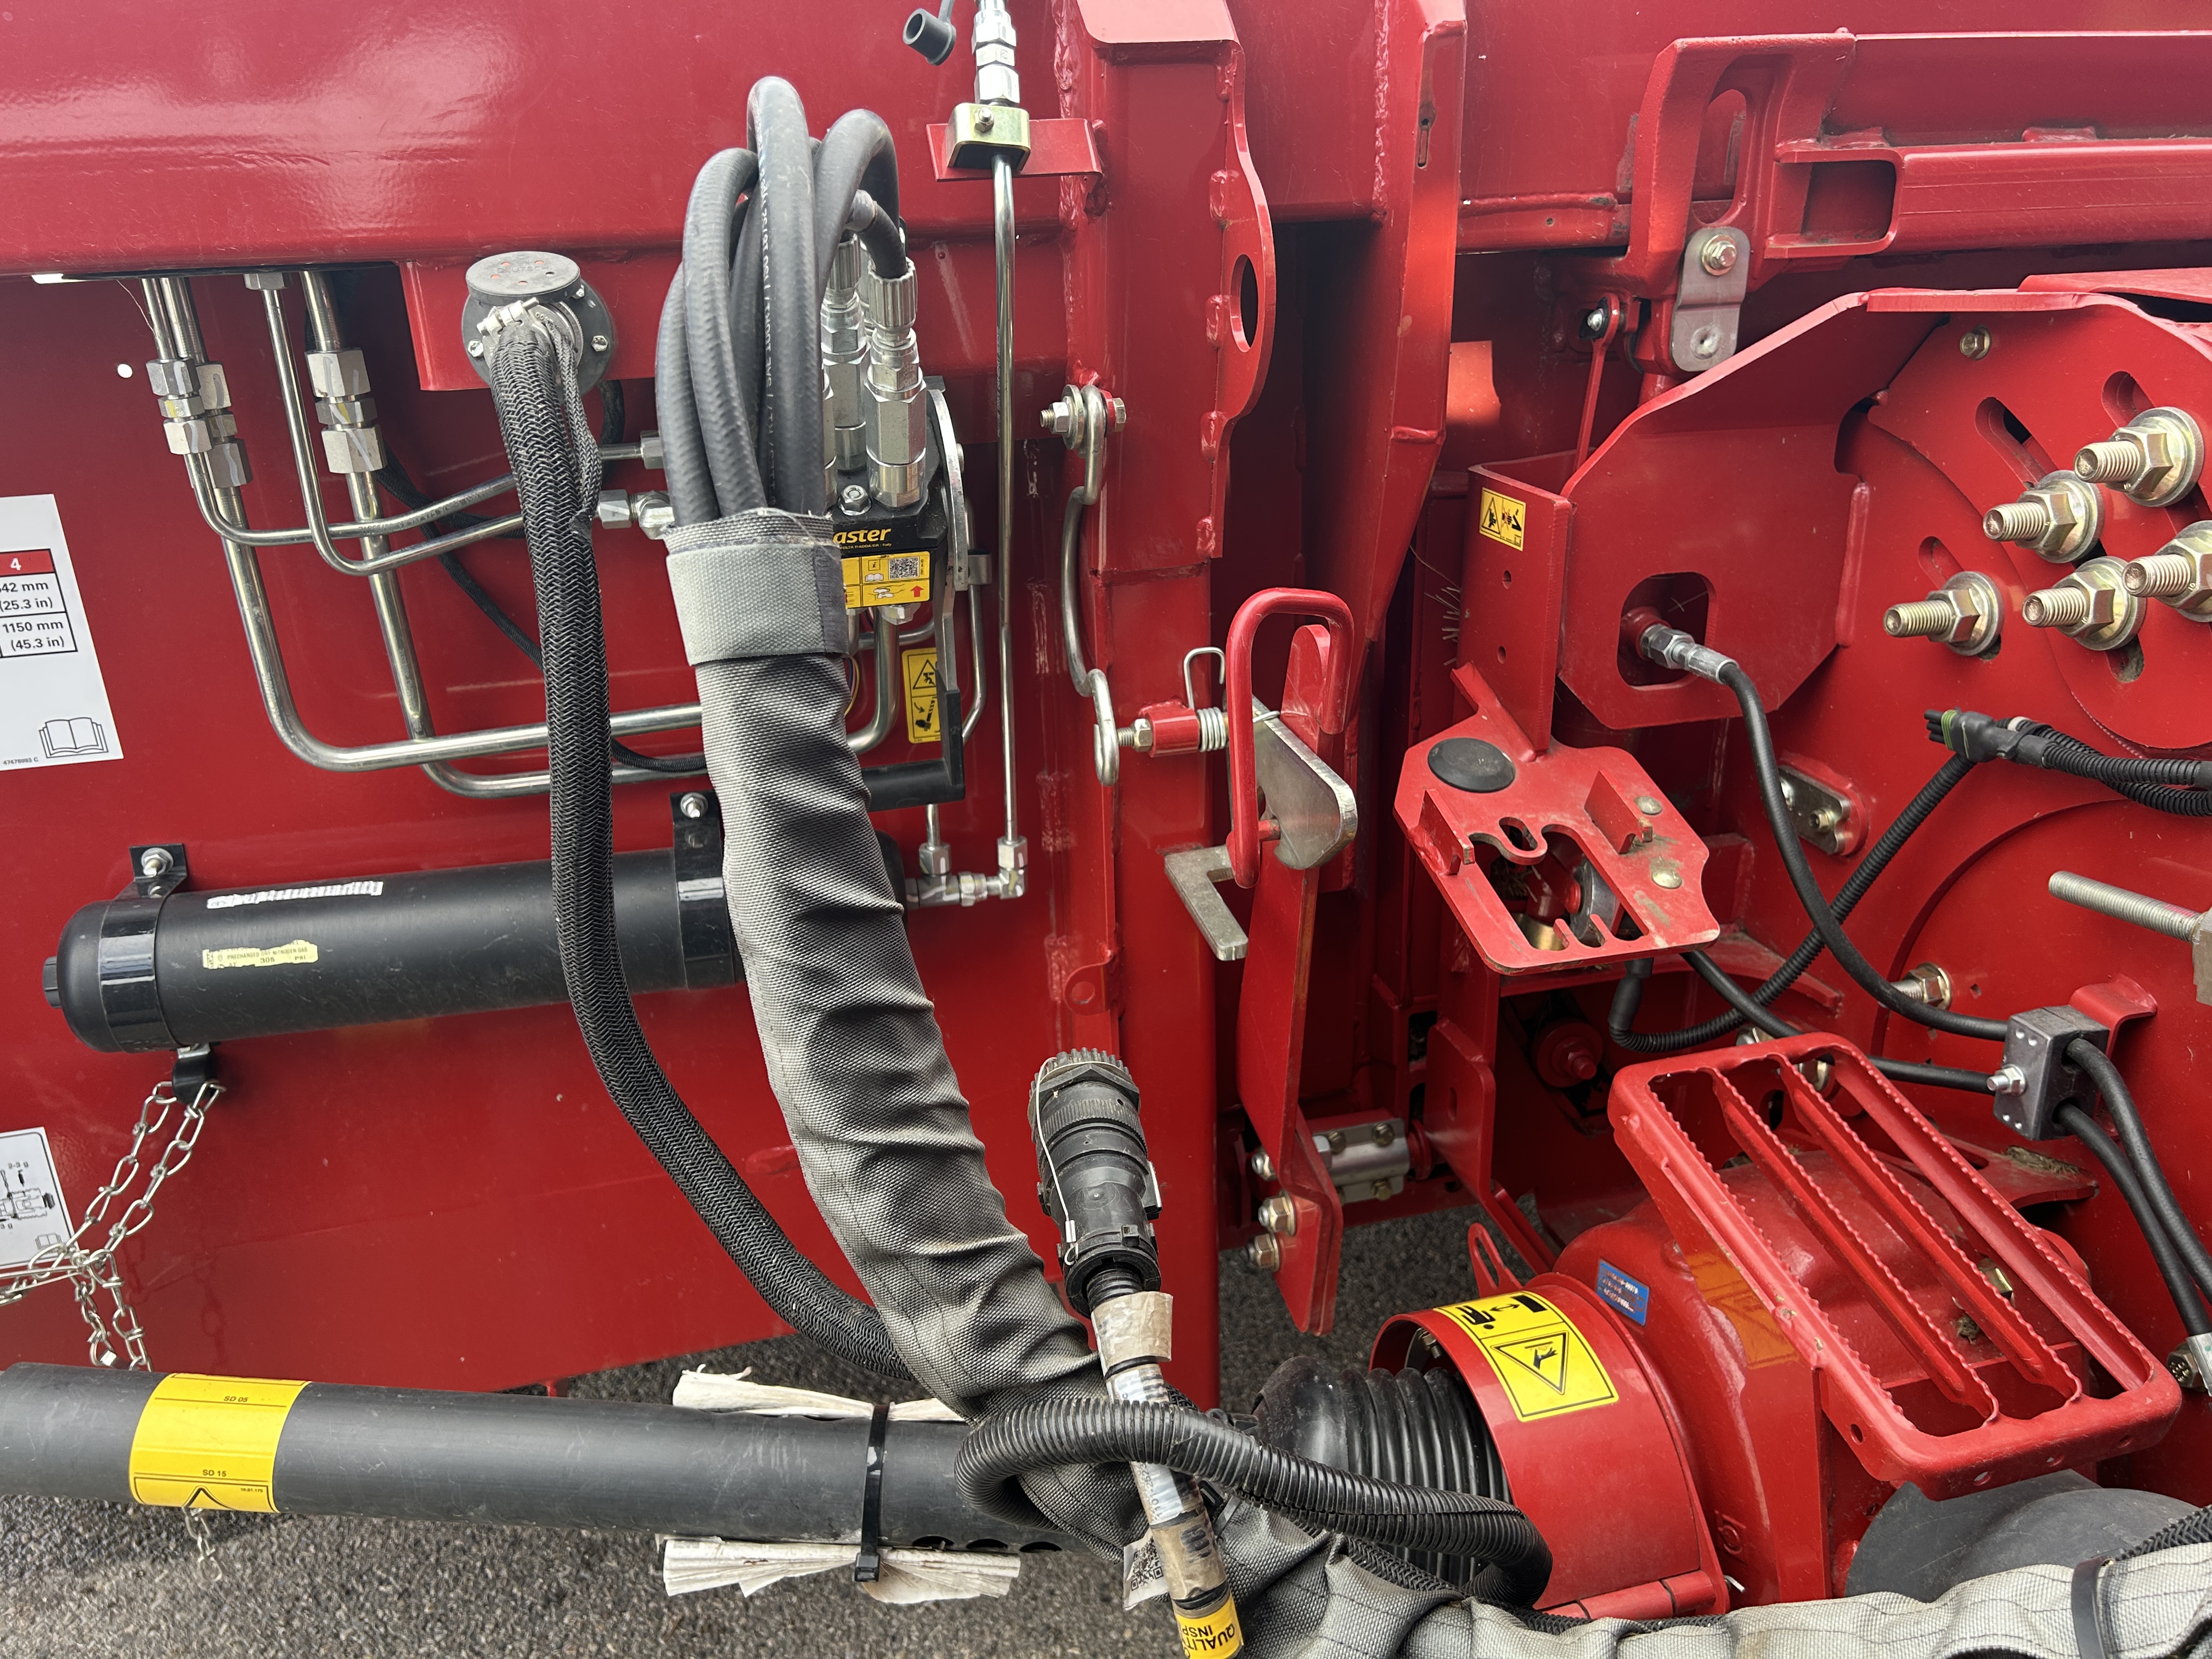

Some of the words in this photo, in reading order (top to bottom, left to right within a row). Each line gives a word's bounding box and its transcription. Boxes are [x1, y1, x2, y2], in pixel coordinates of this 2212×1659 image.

[497, 265, 549, 274] DEUTSCH
[10, 557, 22, 571] 4
[0, 582, 18, 593] 42
[22, 582, 49, 591] mm
[0, 599, 32, 612] (25.3
[35, 596, 53, 609] in)
[2, 621, 33, 633] 1150
[37, 620, 64, 631] mm
[10, 638, 43, 652] (45.3
[46, 635, 64, 647] in)
[227, 951, 259, 960] PRECHARGED
